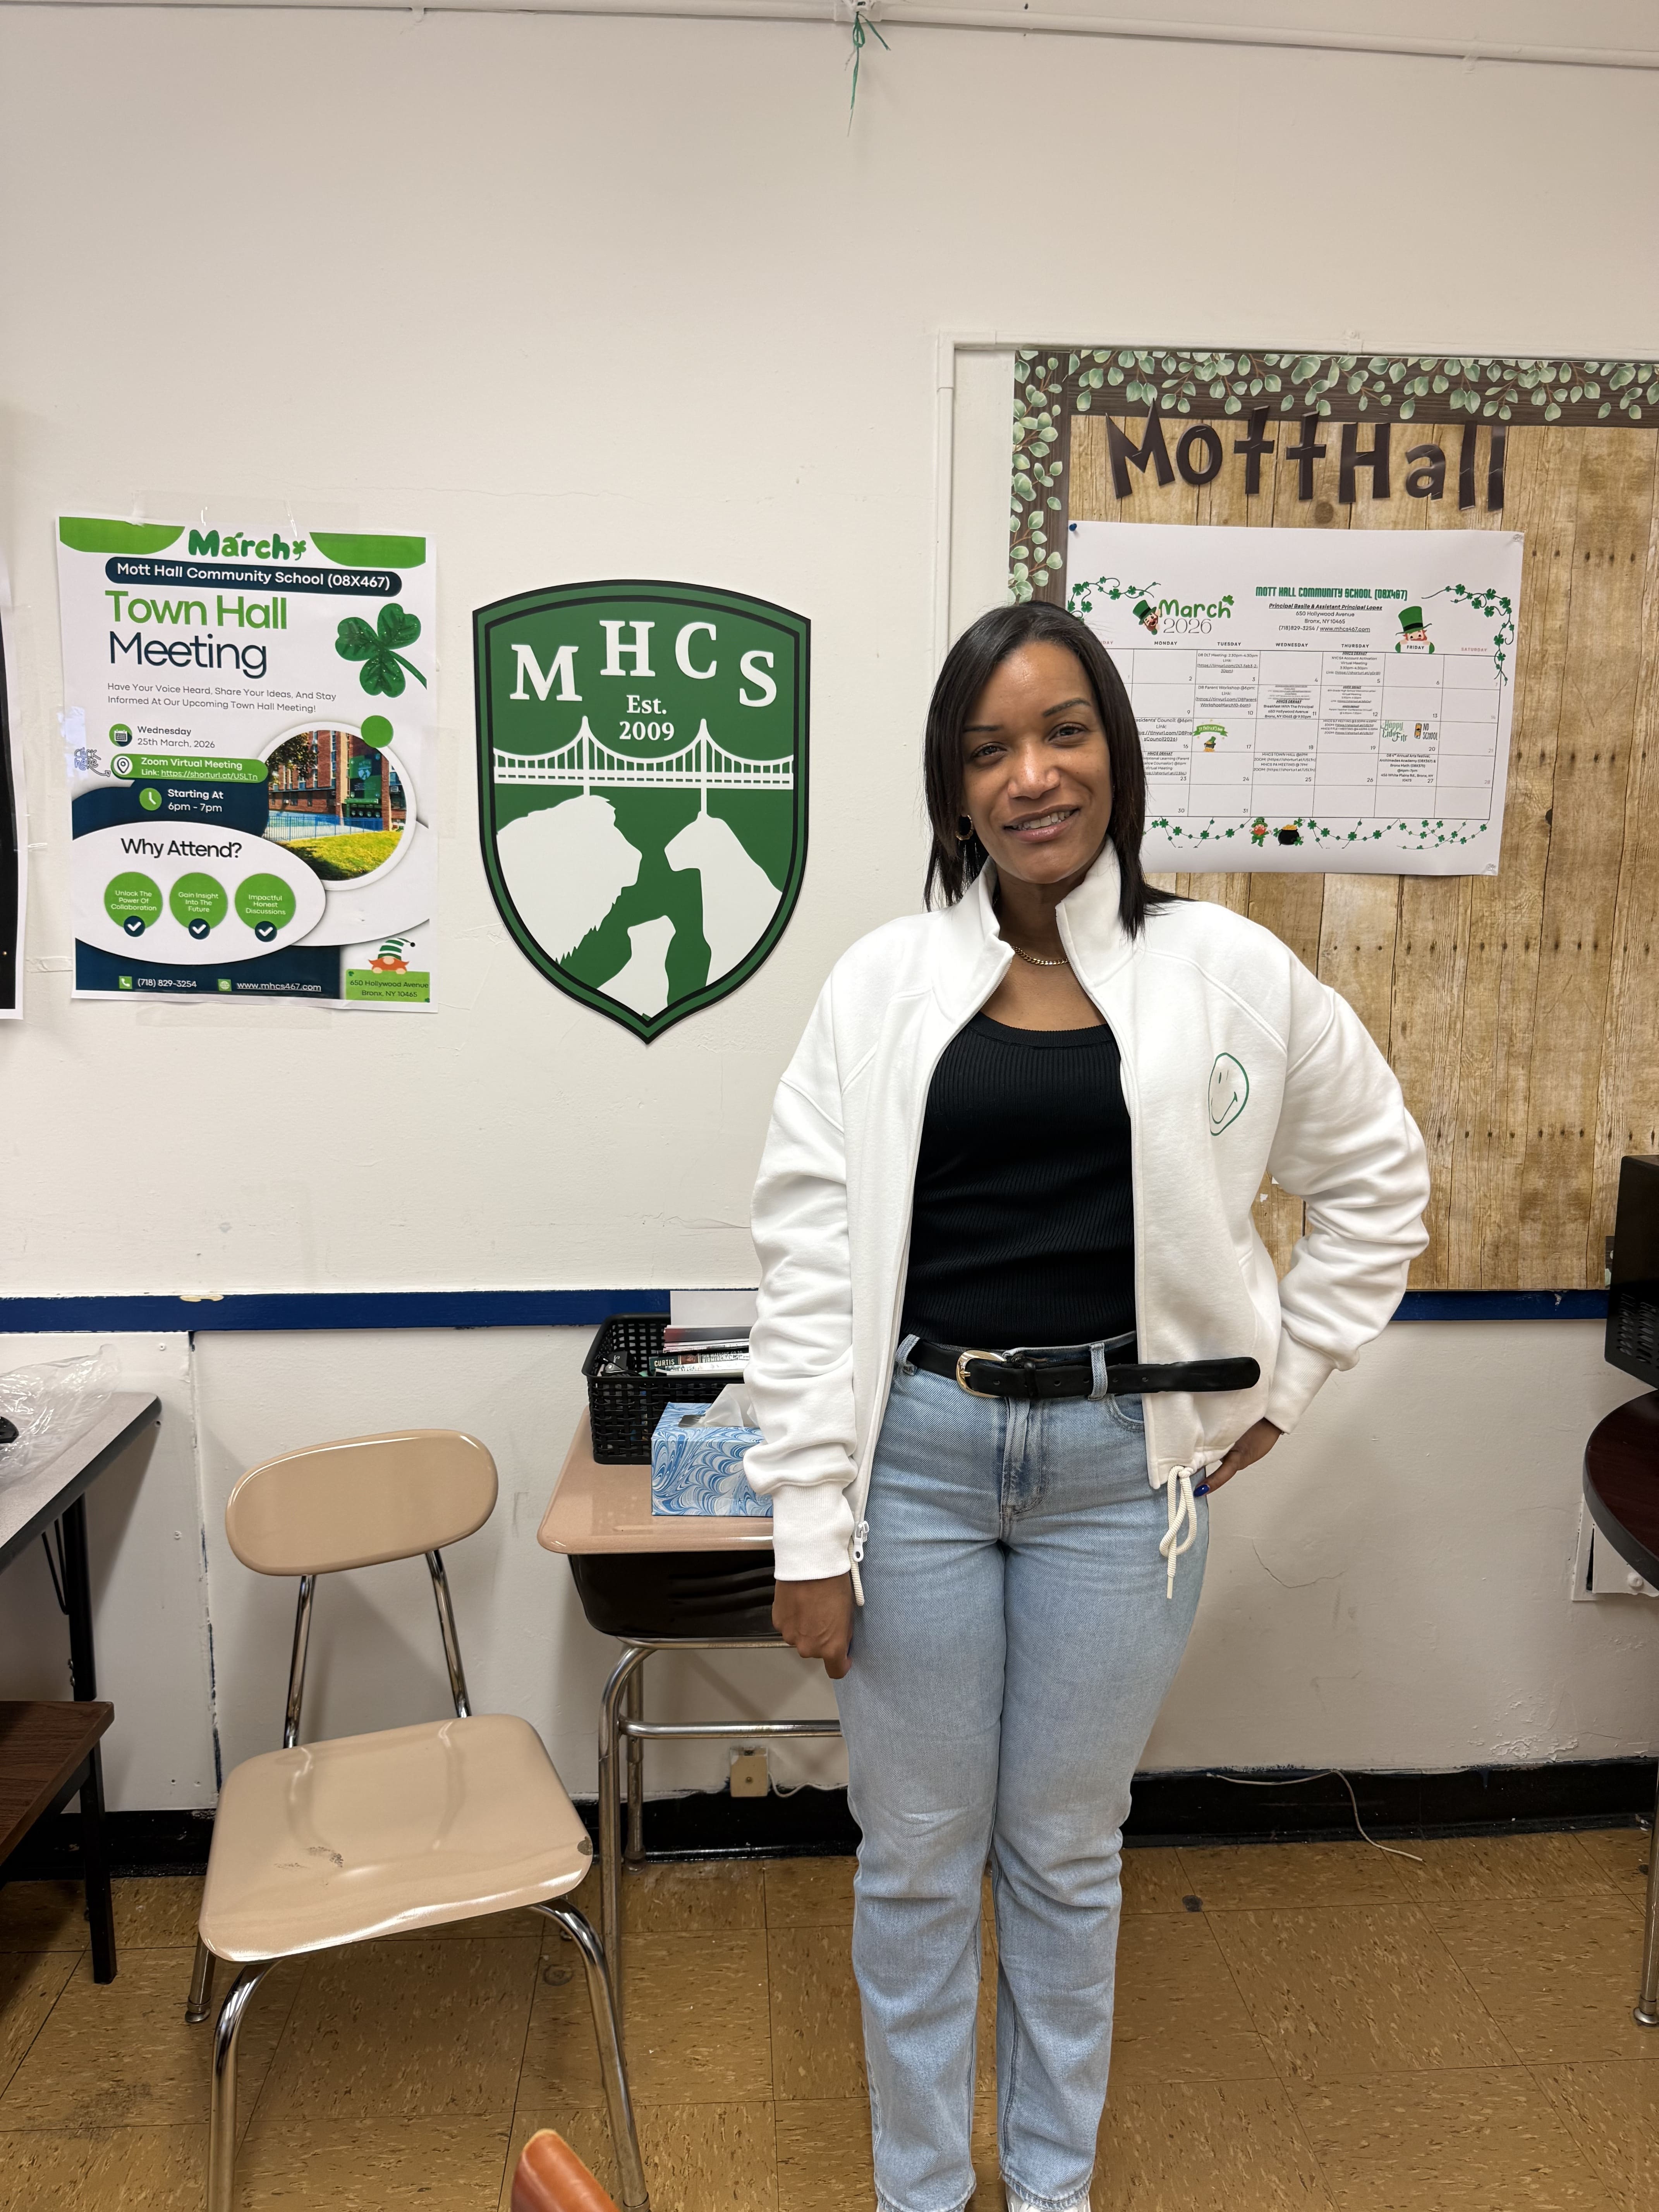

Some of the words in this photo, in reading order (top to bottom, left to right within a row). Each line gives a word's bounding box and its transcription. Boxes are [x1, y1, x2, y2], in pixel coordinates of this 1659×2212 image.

[188, 529, 290, 560] March
[117, 563, 151, 575] Mott
[155, 565, 182, 577] Hall
[187, 567, 271, 584] Community
[275, 572, 324, 585] School
[328, 574, 390, 590] (08X467)
[1255, 587, 1277, 597] MOTT
[1279, 587, 1296, 597] HALL
[1298, 587, 1343, 598] COMMUNITY
[1345, 588, 1372, 598] SCHOOL
[105, 590, 207, 625] Town
[217, 595, 287, 629] Hall
[1158, 599, 1231, 618] March
[1163, 618, 1212, 634] 2026
[110, 631, 267, 679] Meeting
[183, 686, 213, 695] Heard,
[215, 687, 241, 696] Share
[267, 690, 293, 699] Ideas,
[316, 692, 336, 701] Stay
[108, 696, 149, 704] Informed
[182, 699, 228, 709] Upcoming
[277, 704, 316, 713] Meeting!
[626, 695, 667, 715] Est.
[137, 726, 191, 736] Wednesday
[619, 721, 675, 741] 2009
[1423, 732, 1437, 740] SCHOOL
[161, 739, 191, 747] March,
[141, 757, 168, 766] Zoom
[170, 759, 202, 767] Virtual
[205, 761, 242, 770] Meeting
[168, 789, 209, 800] Starting
[212, 791, 223, 799] At
[168, 802, 191, 811] 6pm
[200, 804, 222, 813] 7pm
[120, 838, 164, 858] Why
[167, 840, 242, 858] Attend?
[137, 978, 156, 988] (718)
[158, 979, 197, 988] 829-3254
[237, 982, 322, 991] www.mhcs467.com
[654, 1358, 675, 1367] CURTIS
